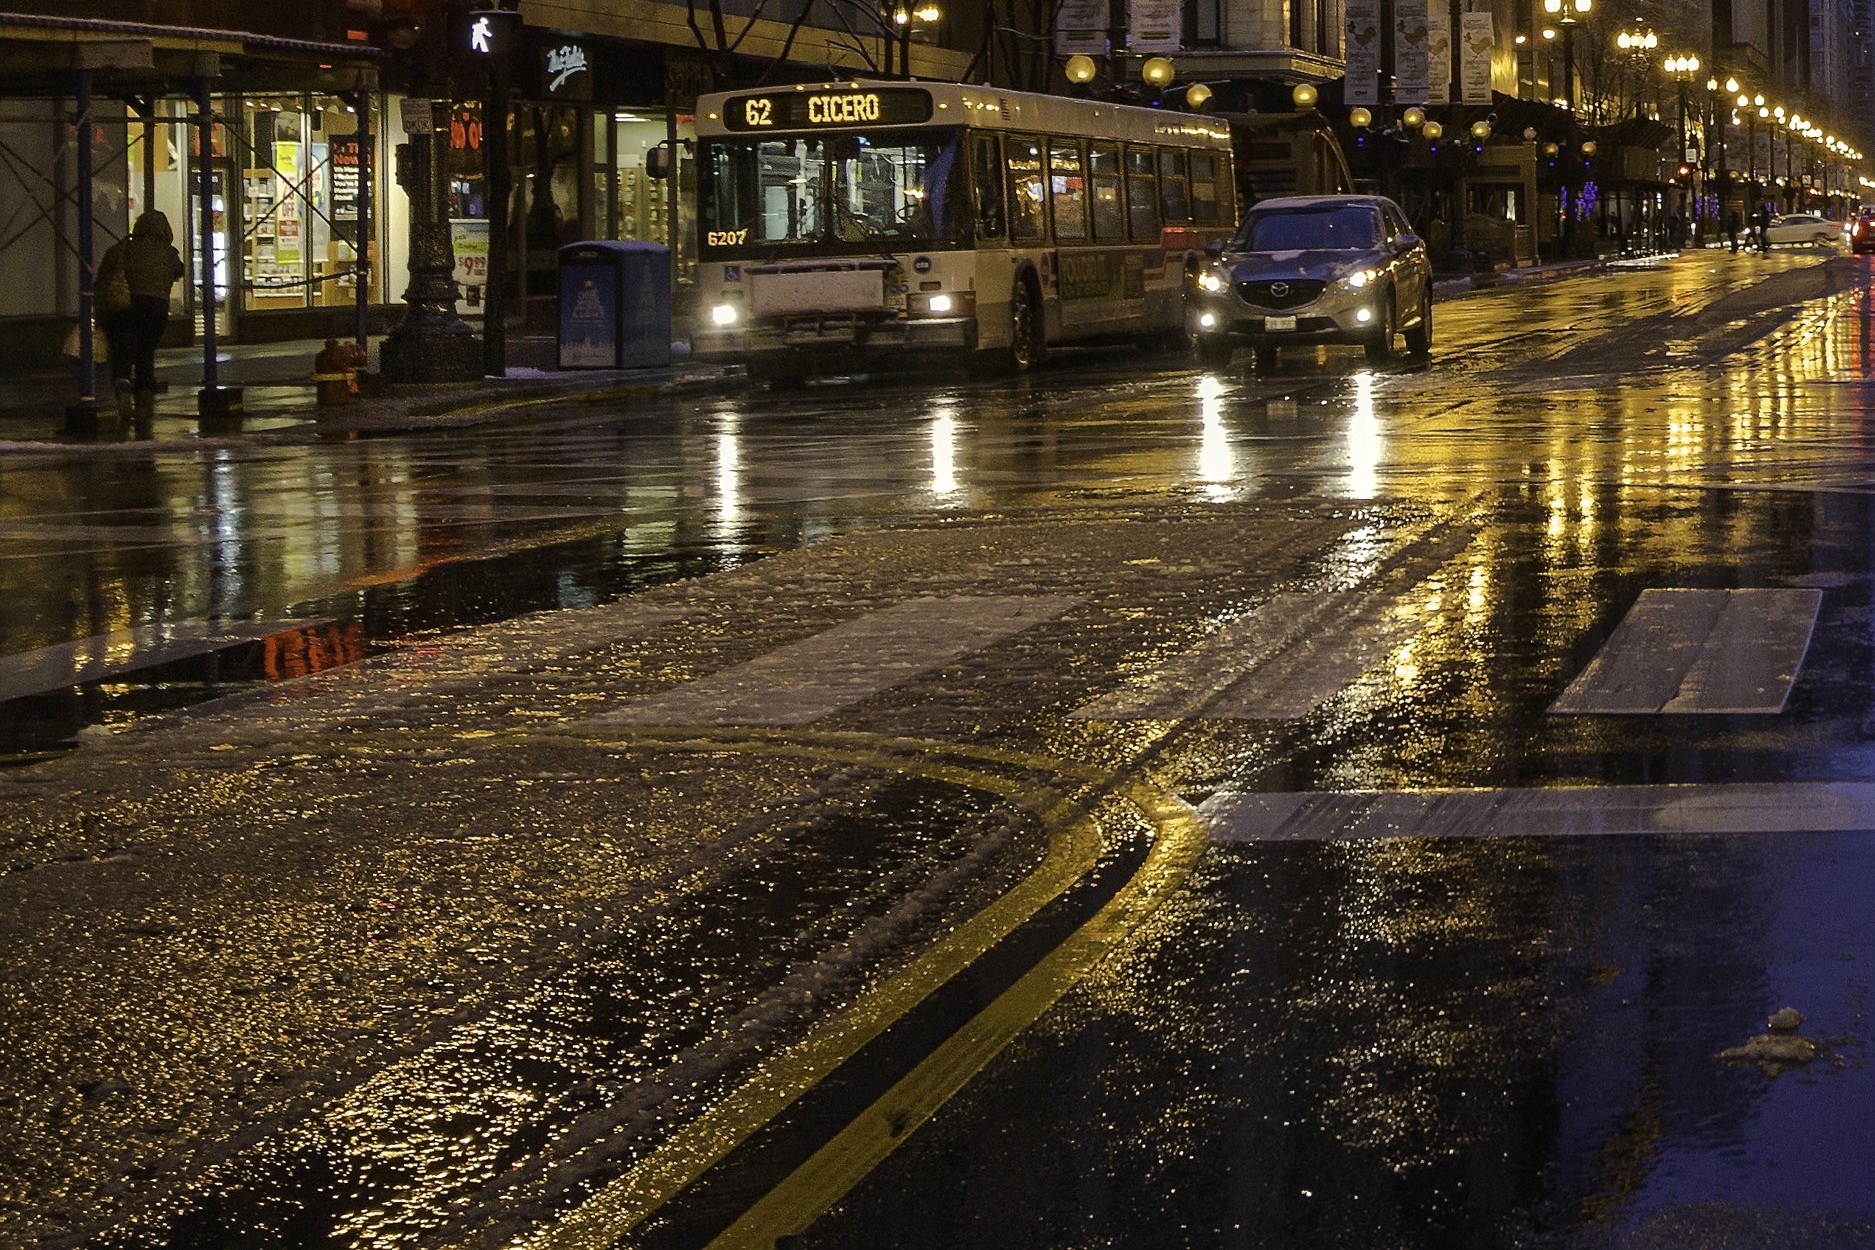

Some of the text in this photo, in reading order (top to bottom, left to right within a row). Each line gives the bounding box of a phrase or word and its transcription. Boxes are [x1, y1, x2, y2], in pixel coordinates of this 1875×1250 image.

[745, 94, 880, 126] 62 CICERO
[707, 229, 748, 247] 6207
